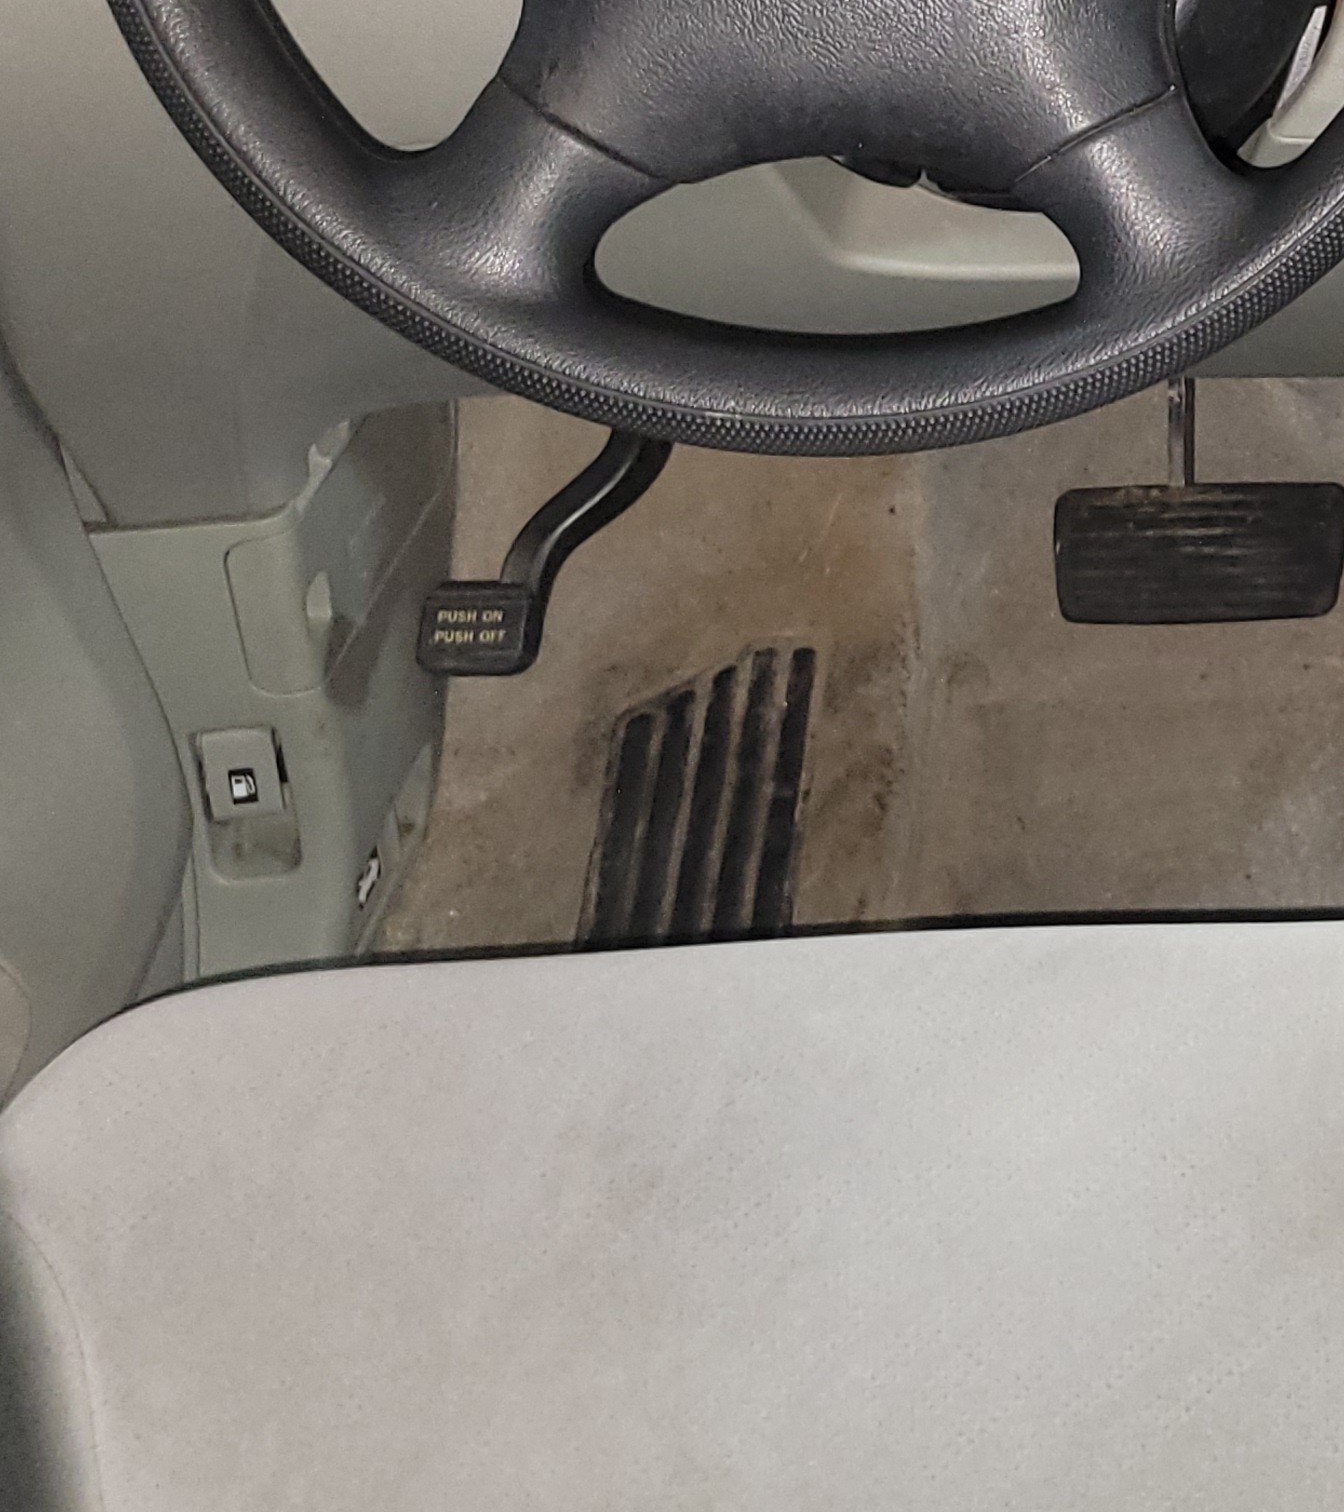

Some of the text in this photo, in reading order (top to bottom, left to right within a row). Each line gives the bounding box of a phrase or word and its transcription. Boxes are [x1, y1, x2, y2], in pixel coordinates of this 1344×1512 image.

[437, 609, 503, 623] PUSH ON
[434, 629, 505, 643] PUSH OFF
